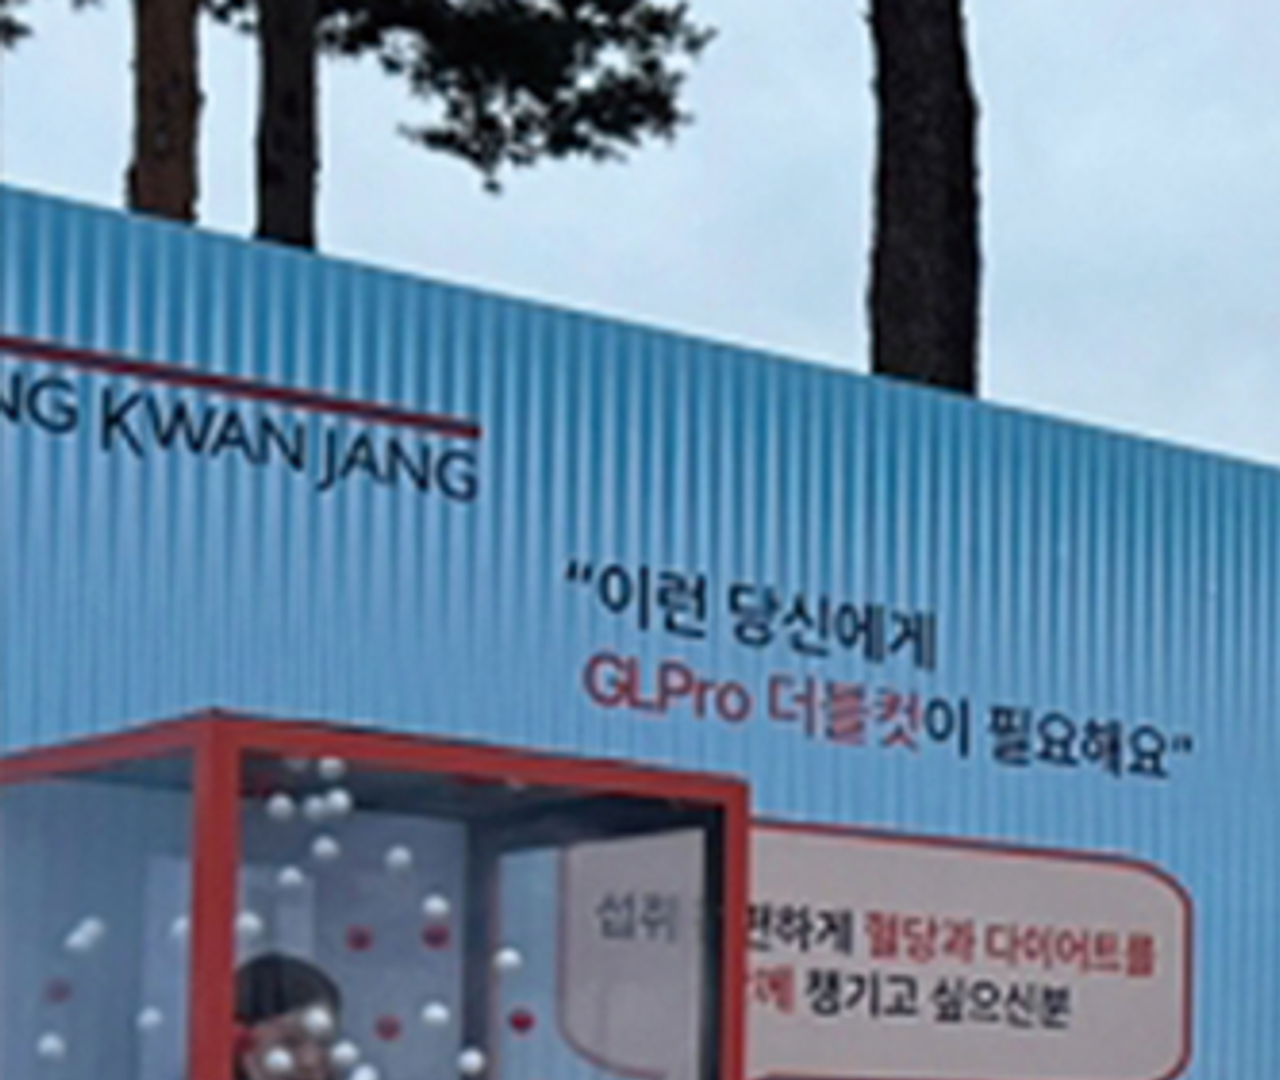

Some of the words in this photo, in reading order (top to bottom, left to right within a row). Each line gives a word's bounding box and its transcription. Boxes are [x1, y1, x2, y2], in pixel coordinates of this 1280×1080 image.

[100, 388, 306, 473] KWAN
[316, 428, 480, 503] JANG
[728, 582, 936, 671] 당신에게
[583, 652, 750, 724] GLPro
[768, 672, 970, 757] 더블컷이
[596, 890, 678, 943] 섭취
[746, 903, 854, 957] 편하게
[863, 910, 977, 965] 혈당과
[984, 921, 1155, 979] 다이어트를
[804, 967, 920, 1018] 챙기고
